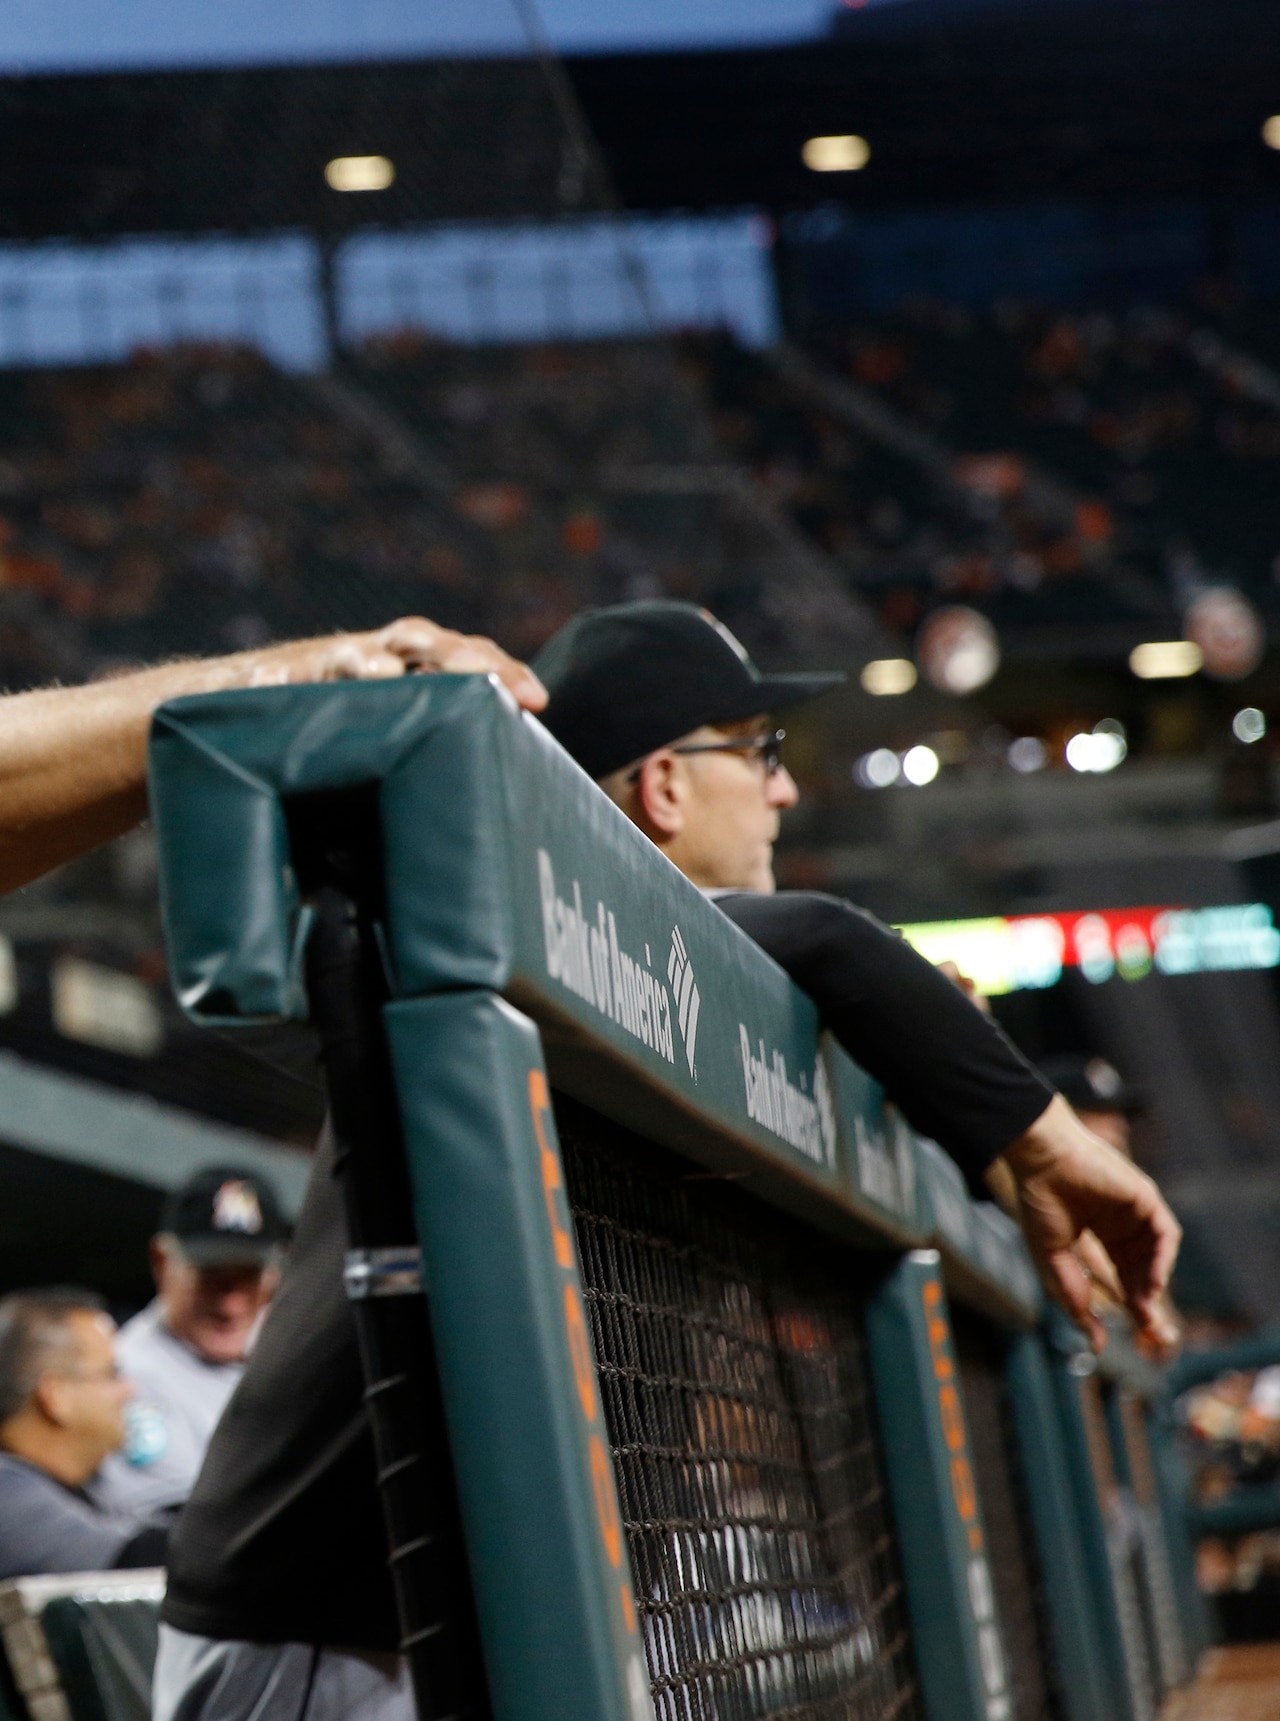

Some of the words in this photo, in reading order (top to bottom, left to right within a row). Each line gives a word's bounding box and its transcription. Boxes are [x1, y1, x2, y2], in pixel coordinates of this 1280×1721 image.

[537, 849, 596, 1008] Bank
[590, 901, 613, 1019] of
[608, 910, 675, 1064] America
